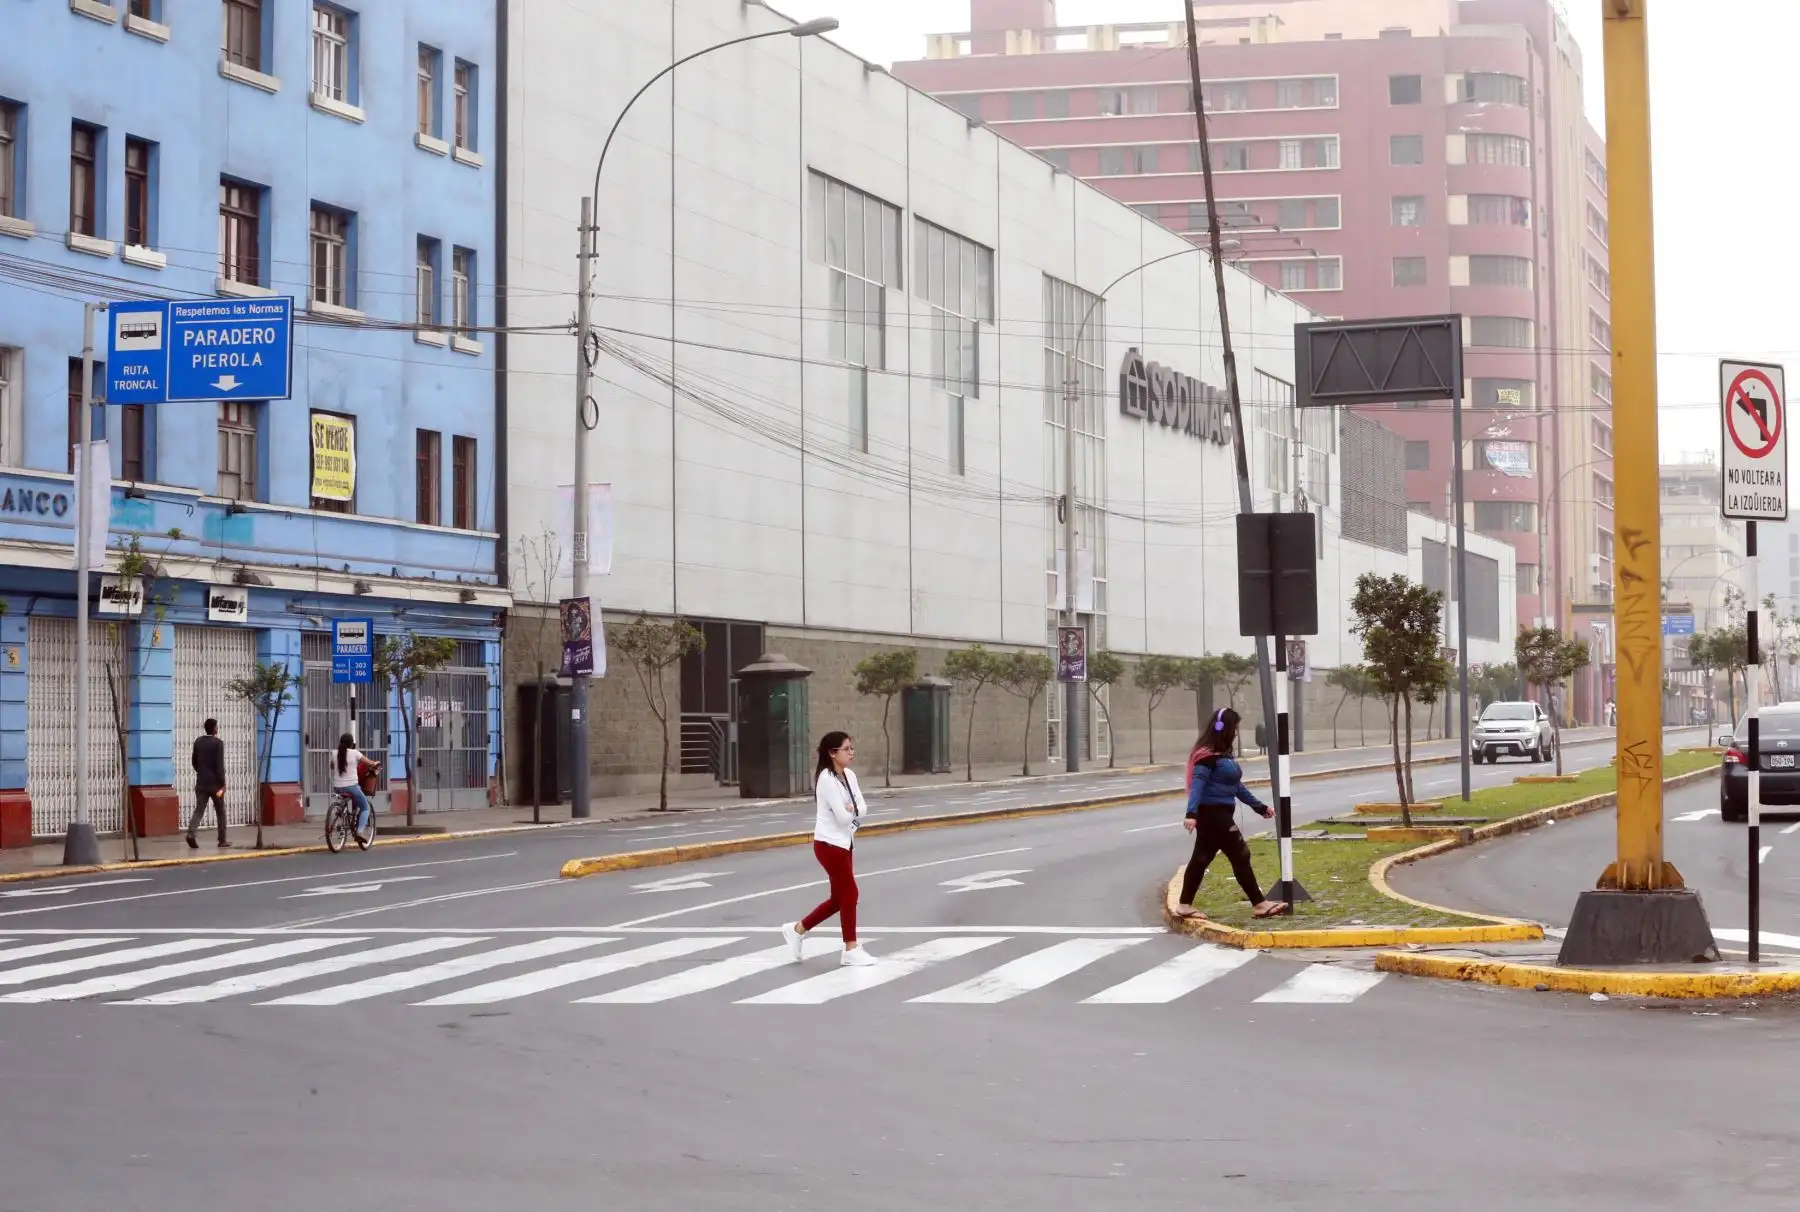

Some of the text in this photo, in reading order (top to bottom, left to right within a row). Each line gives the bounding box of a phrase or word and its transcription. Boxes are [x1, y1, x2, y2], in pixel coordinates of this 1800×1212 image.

[176, 304, 284, 317] Respetemos las Normas
[183, 328, 275, 346] PARADERO
[192, 352, 262, 368] PIEROLA
[123, 365, 149, 376] RUTA
[114, 379, 159, 390] TRONCAL
[1728, 468, 1782, 486] NO VOLTEAR A
[1728, 494, 1739, 510] LA
[336, 644, 368, 654] PARADERO
